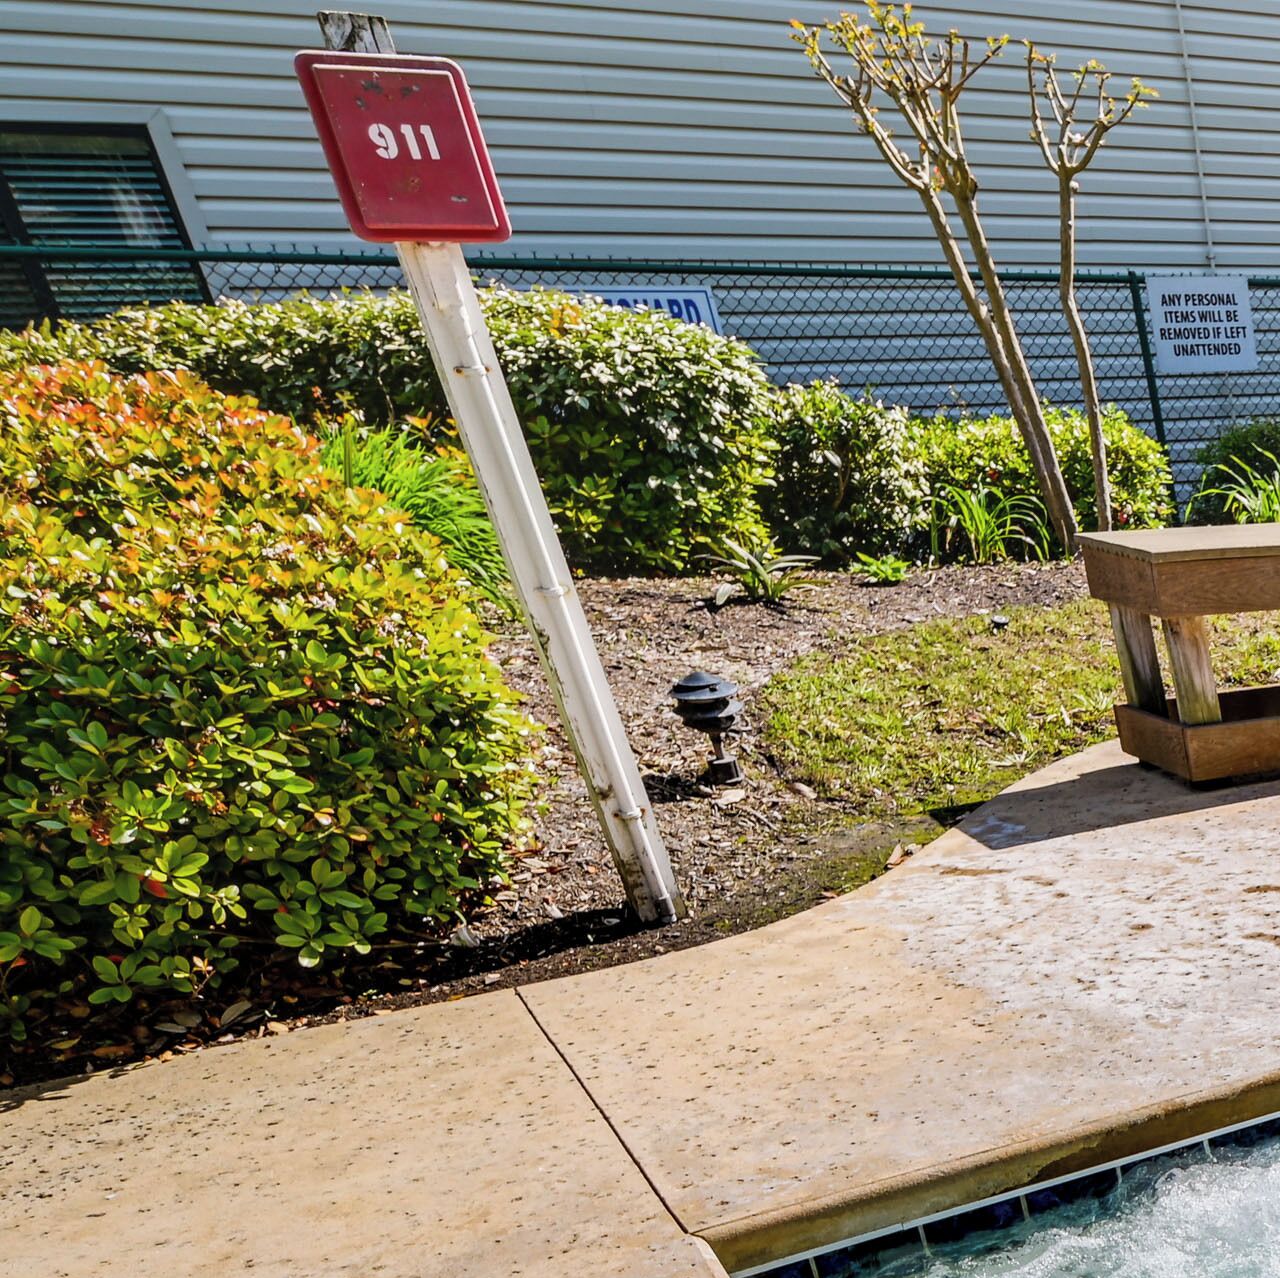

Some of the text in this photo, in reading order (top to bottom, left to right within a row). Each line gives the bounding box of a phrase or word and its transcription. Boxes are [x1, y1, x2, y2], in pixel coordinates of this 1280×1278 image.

[368, 123, 441, 160] 911
[1161, 293, 1238, 307] ANY PERSONAL
[1164, 310, 1239, 323] ITEMS WILL BE
[1160, 326, 1247, 340] REMOVED IF LEFT
[1173, 343, 1241, 357] UNATTENDED
